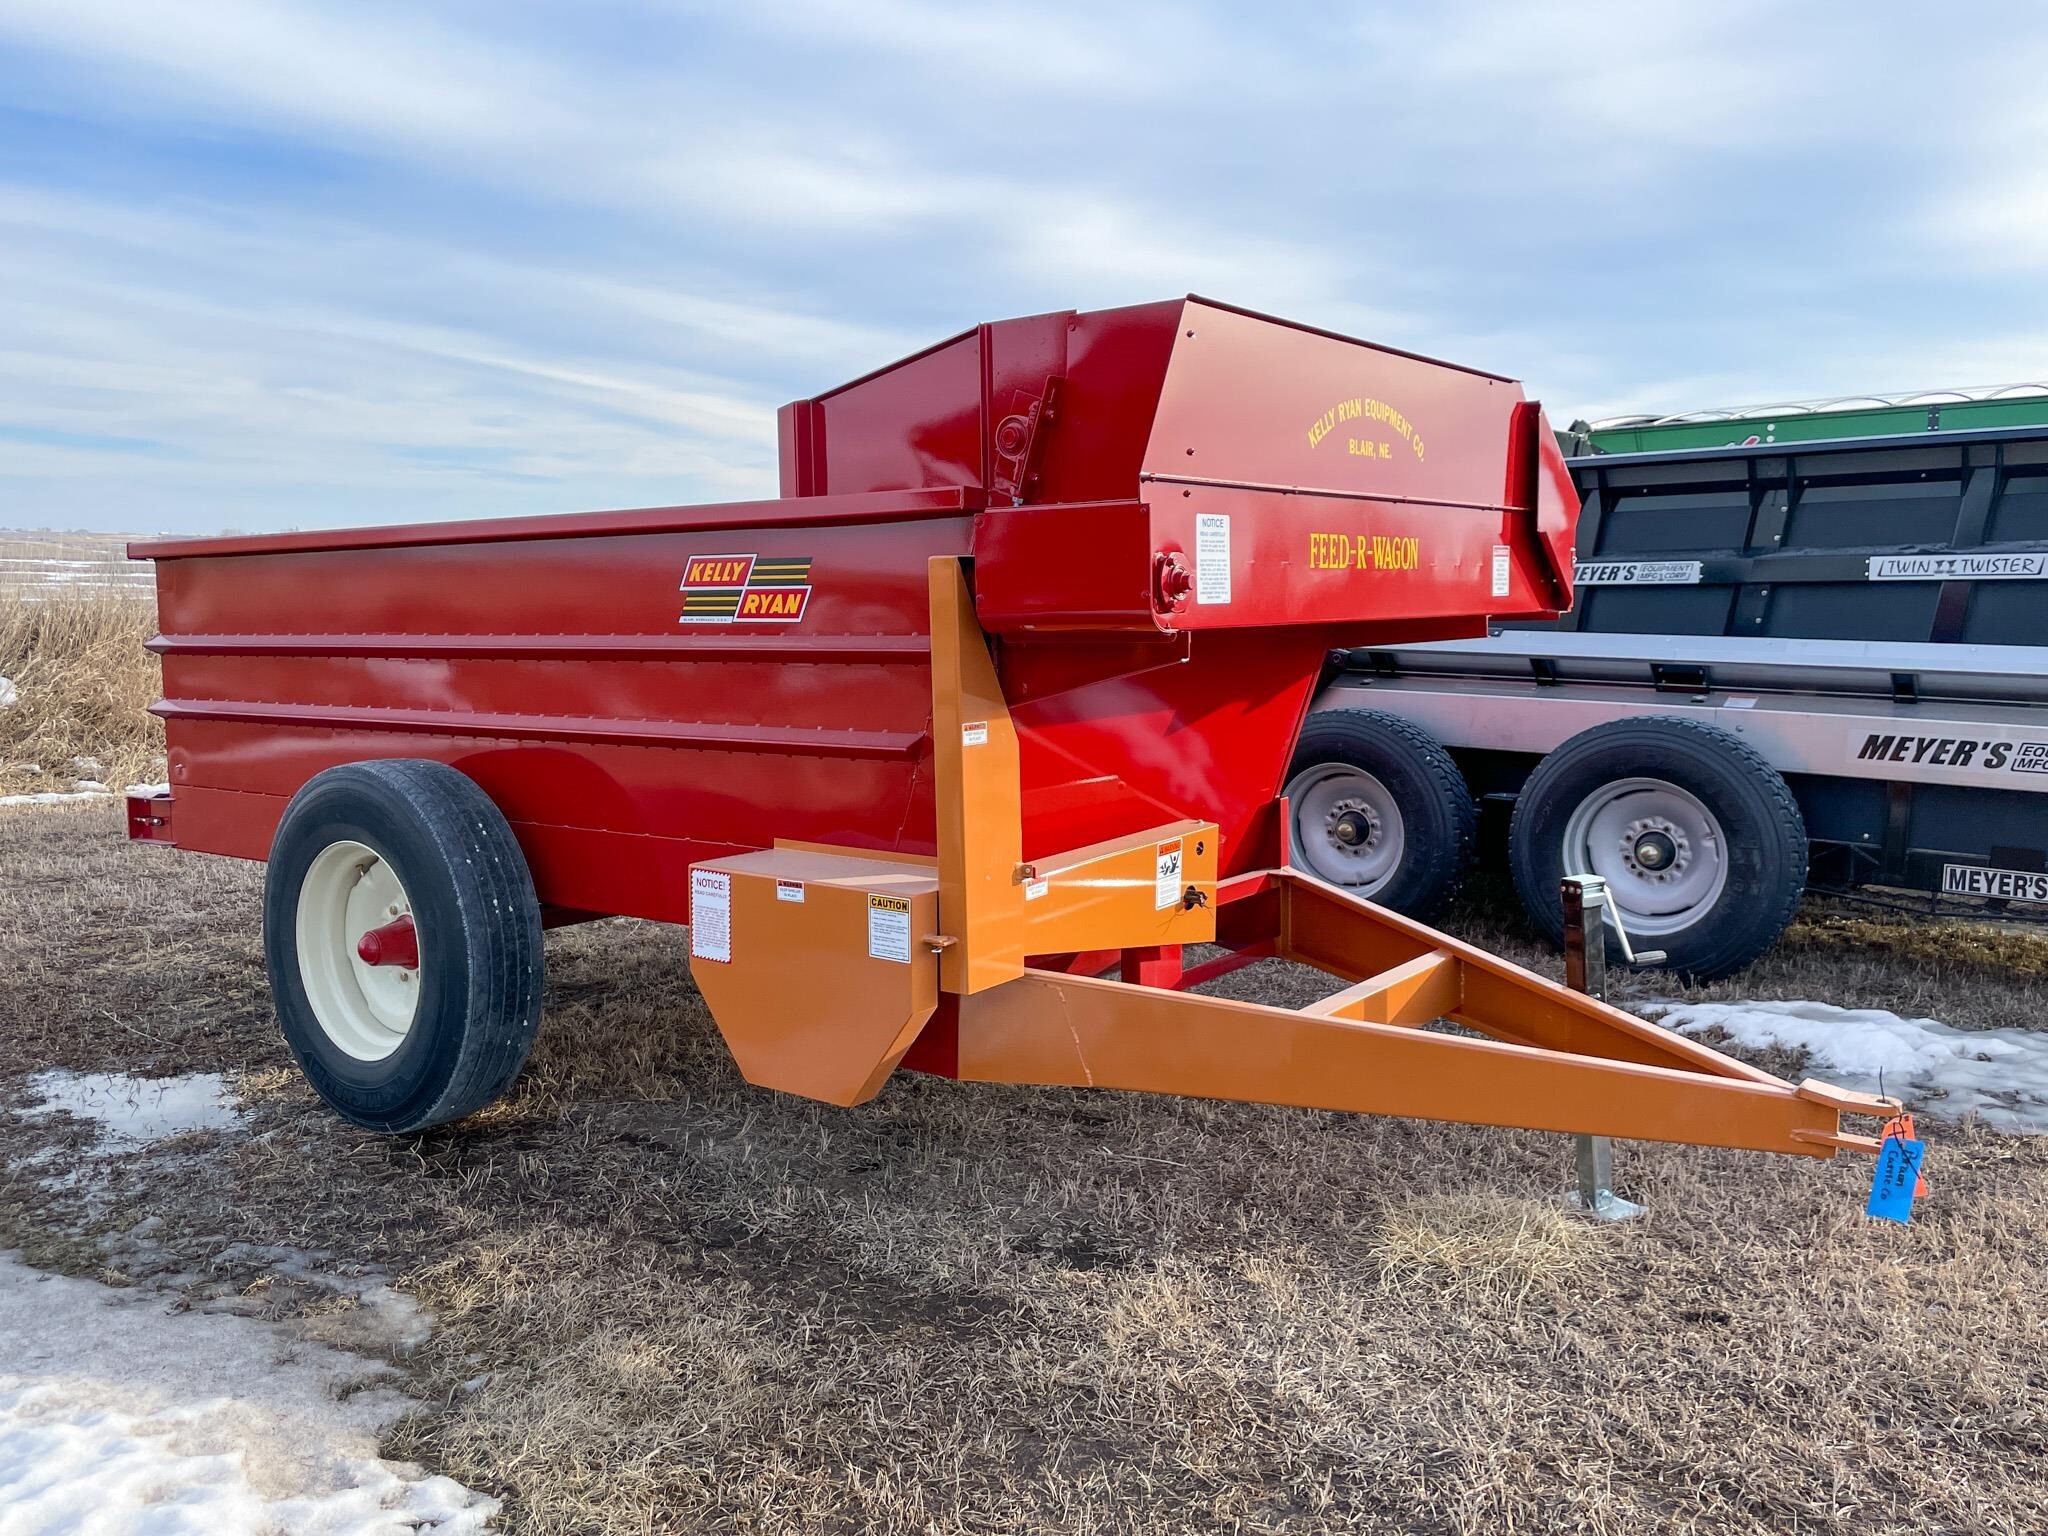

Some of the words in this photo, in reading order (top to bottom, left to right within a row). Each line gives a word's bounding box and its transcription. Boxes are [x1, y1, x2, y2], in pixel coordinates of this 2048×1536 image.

[1307, 407, 1335, 449] KELLY
[1338, 398, 1362, 423] RYAN
[1365, 398, 1413, 441] EQUIPMENT
[1413, 434, 1425, 462] CO.
[1349, 438, 1376, 460] BLAIR,
[1379, 442, 1392, 459] NE.
[1202, 518, 1224, 528] NOTICE
[1309, 533, 1419, 570] FEED-R-WAGON
[688, 562, 746, 582] KELLY
[1888, 560, 1931, 574] TWIN
[1962, 558, 2034, 574] TWISTER
[743, 593, 802, 614] RYAN
[1857, 734, 2013, 769] MEYER'S
[1949, 868, 2048, 900] MEYER'S
[871, 897, 907, 911] CAUTION
